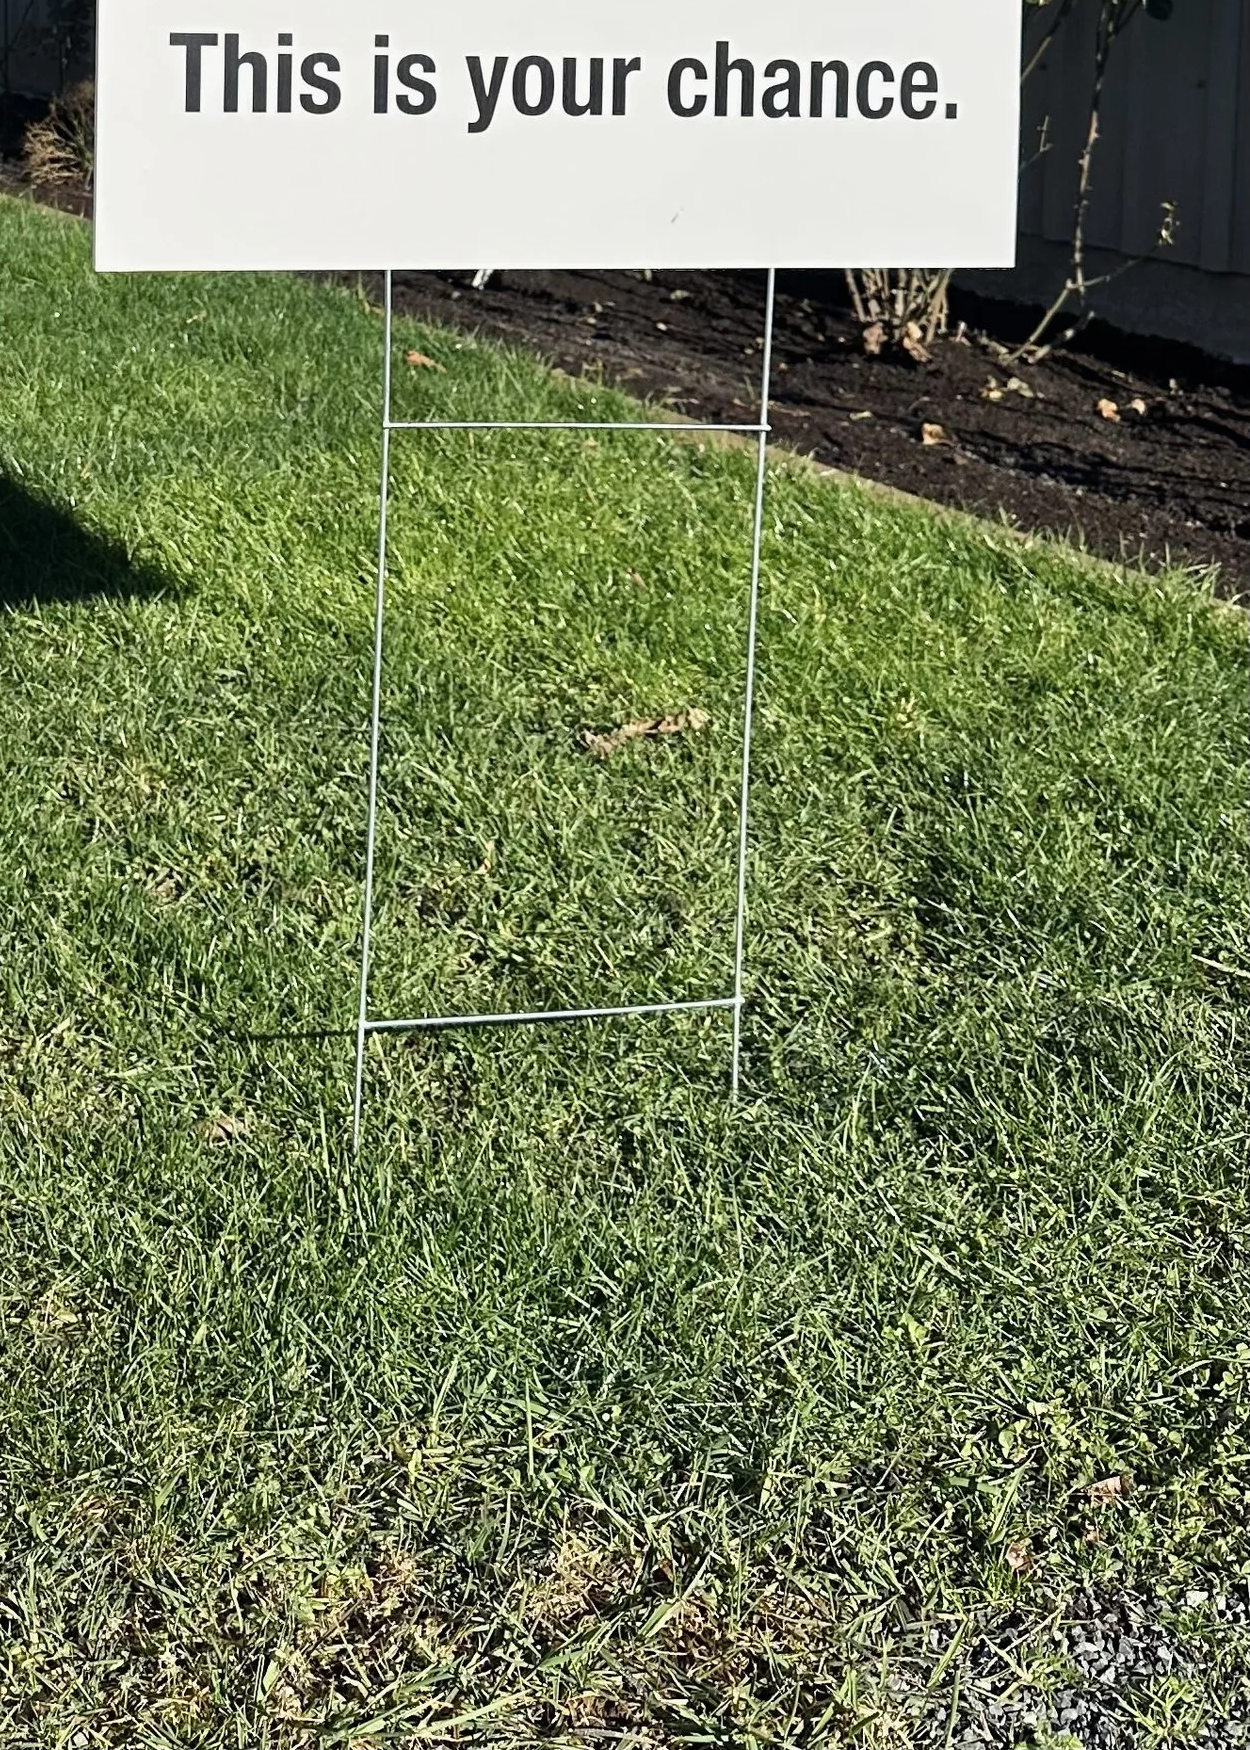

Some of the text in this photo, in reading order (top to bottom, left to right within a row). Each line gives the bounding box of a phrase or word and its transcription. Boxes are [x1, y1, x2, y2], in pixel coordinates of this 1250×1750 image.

[169, 32, 958, 134] This is your chance.
